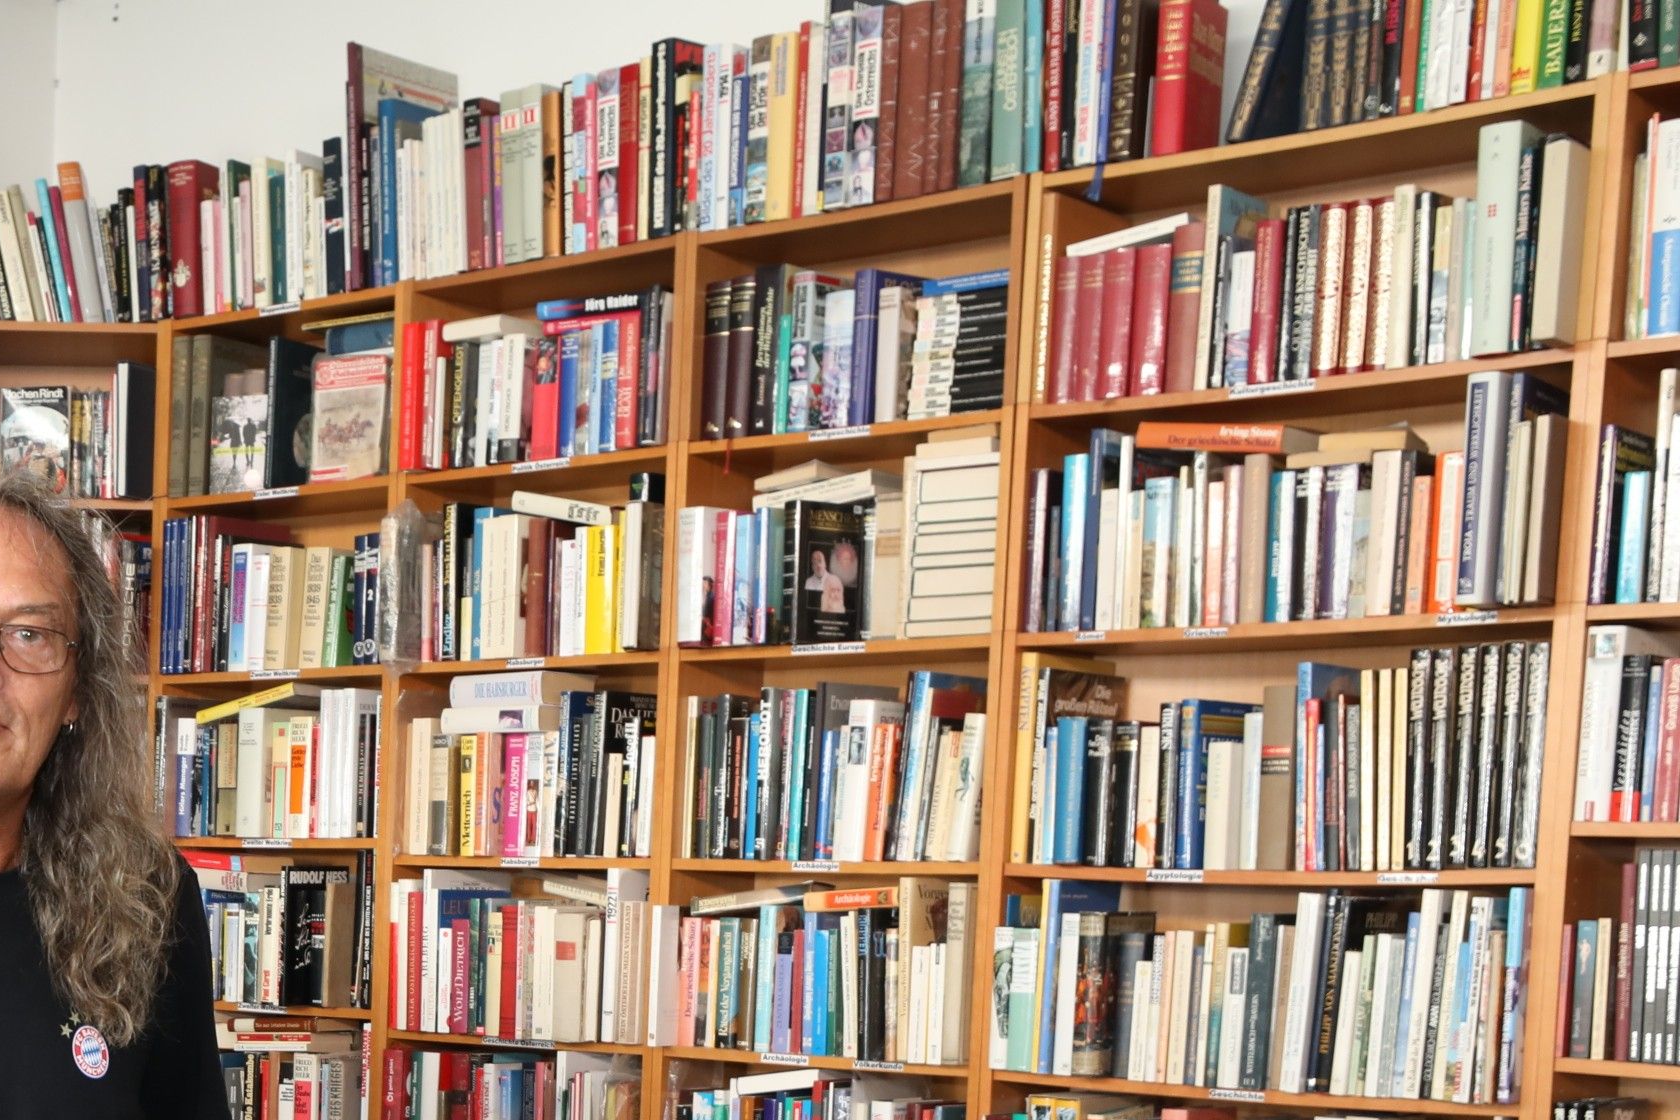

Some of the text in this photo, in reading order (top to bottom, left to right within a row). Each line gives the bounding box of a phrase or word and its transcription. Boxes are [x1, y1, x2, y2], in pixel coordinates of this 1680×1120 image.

[3, 387, 65, 399] Jochen Rindt
[757, 700, 770, 779] HERODOT
[507, 756, 522, 818] FRANZ JOSEPH
[792, 861, 839, 871] Archäologie
[289, 869, 349, 886] RUDOLF HESS
[1147, 869, 1203, 882] Ägyptologie
[762, 1053, 808, 1065] Archäologie
[854, 1061, 905, 1070] Völkerkunde
[1210, 1089, 1265, 1101] Geschichte
